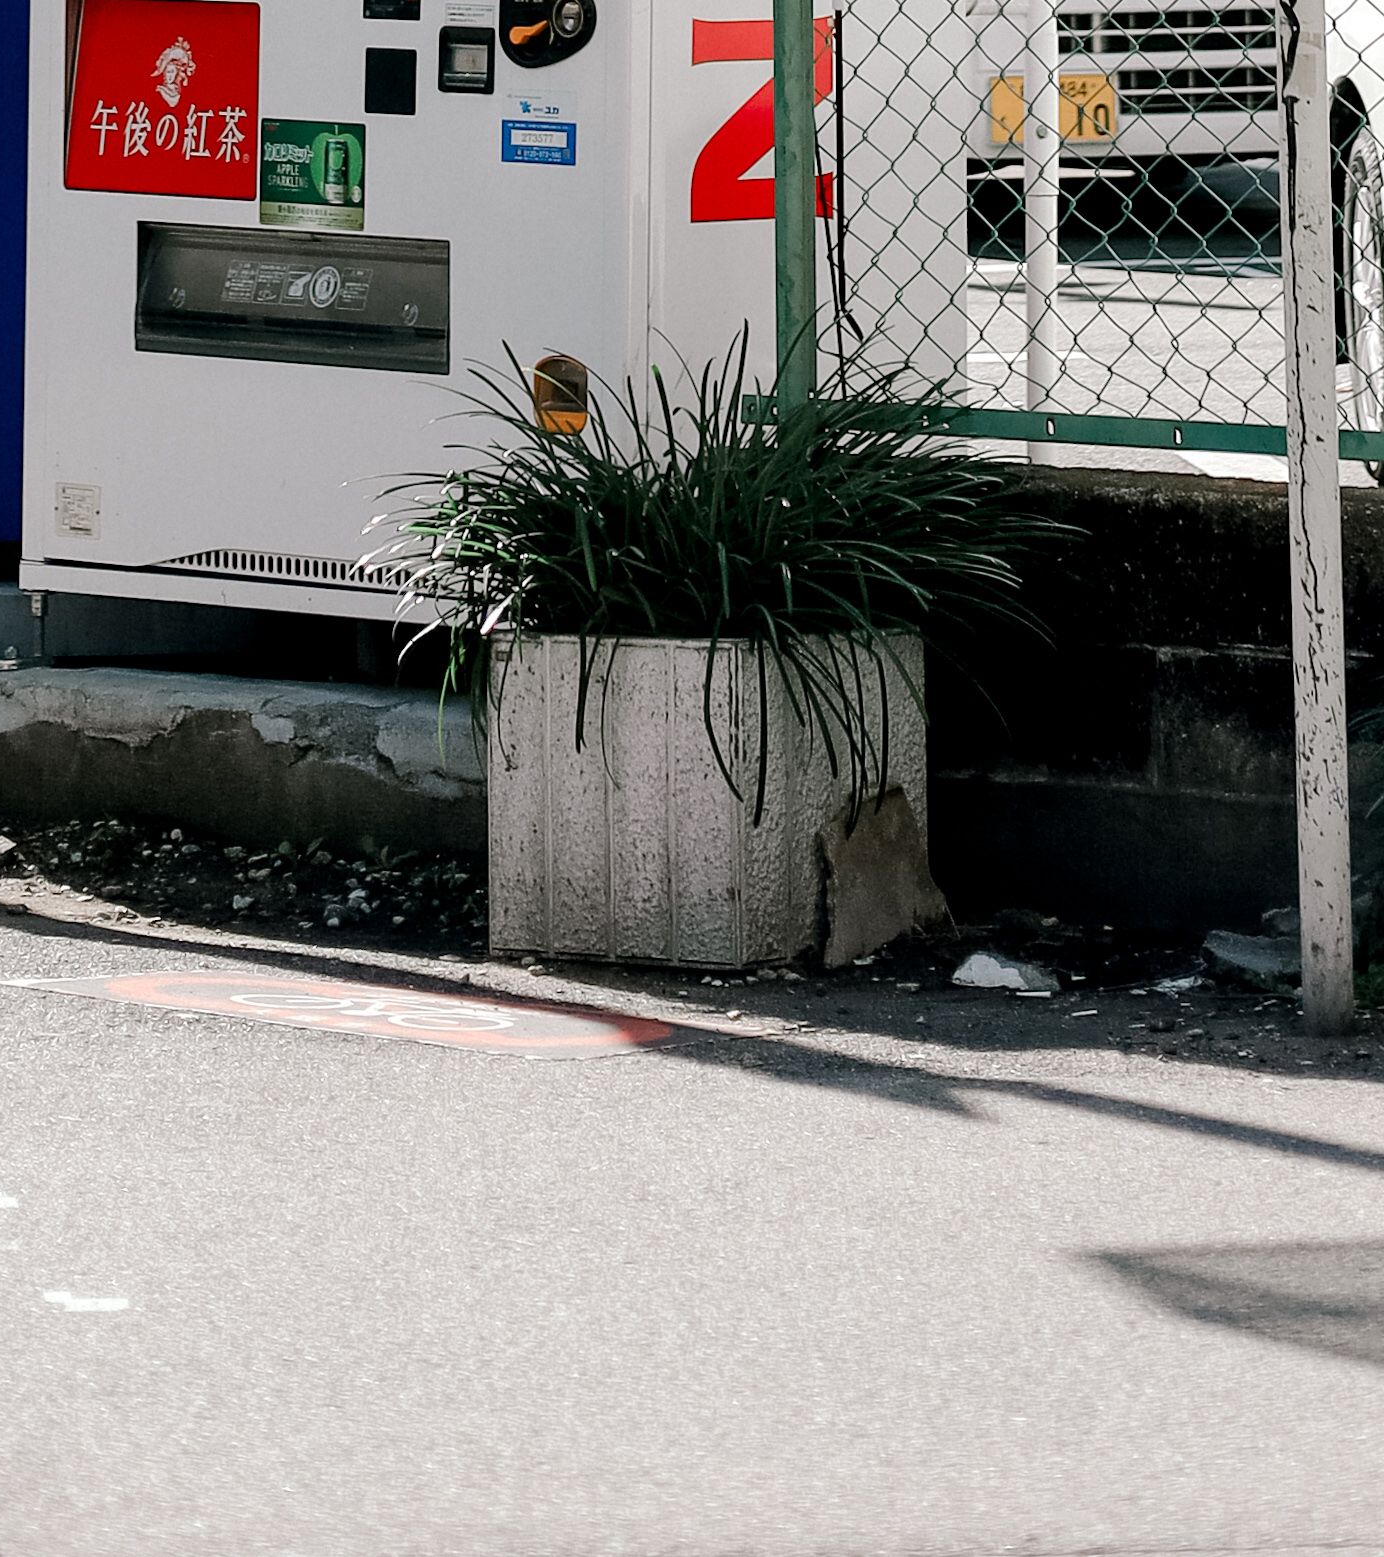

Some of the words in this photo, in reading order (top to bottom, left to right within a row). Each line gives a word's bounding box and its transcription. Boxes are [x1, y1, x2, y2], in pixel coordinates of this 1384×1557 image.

[90, 99, 249, 164] 午後の紅茶
[263, 142, 314, 164] カロリミット
[276, 164, 300, 176] APPLE
[267, 174, 308, 188] SPARKLING
